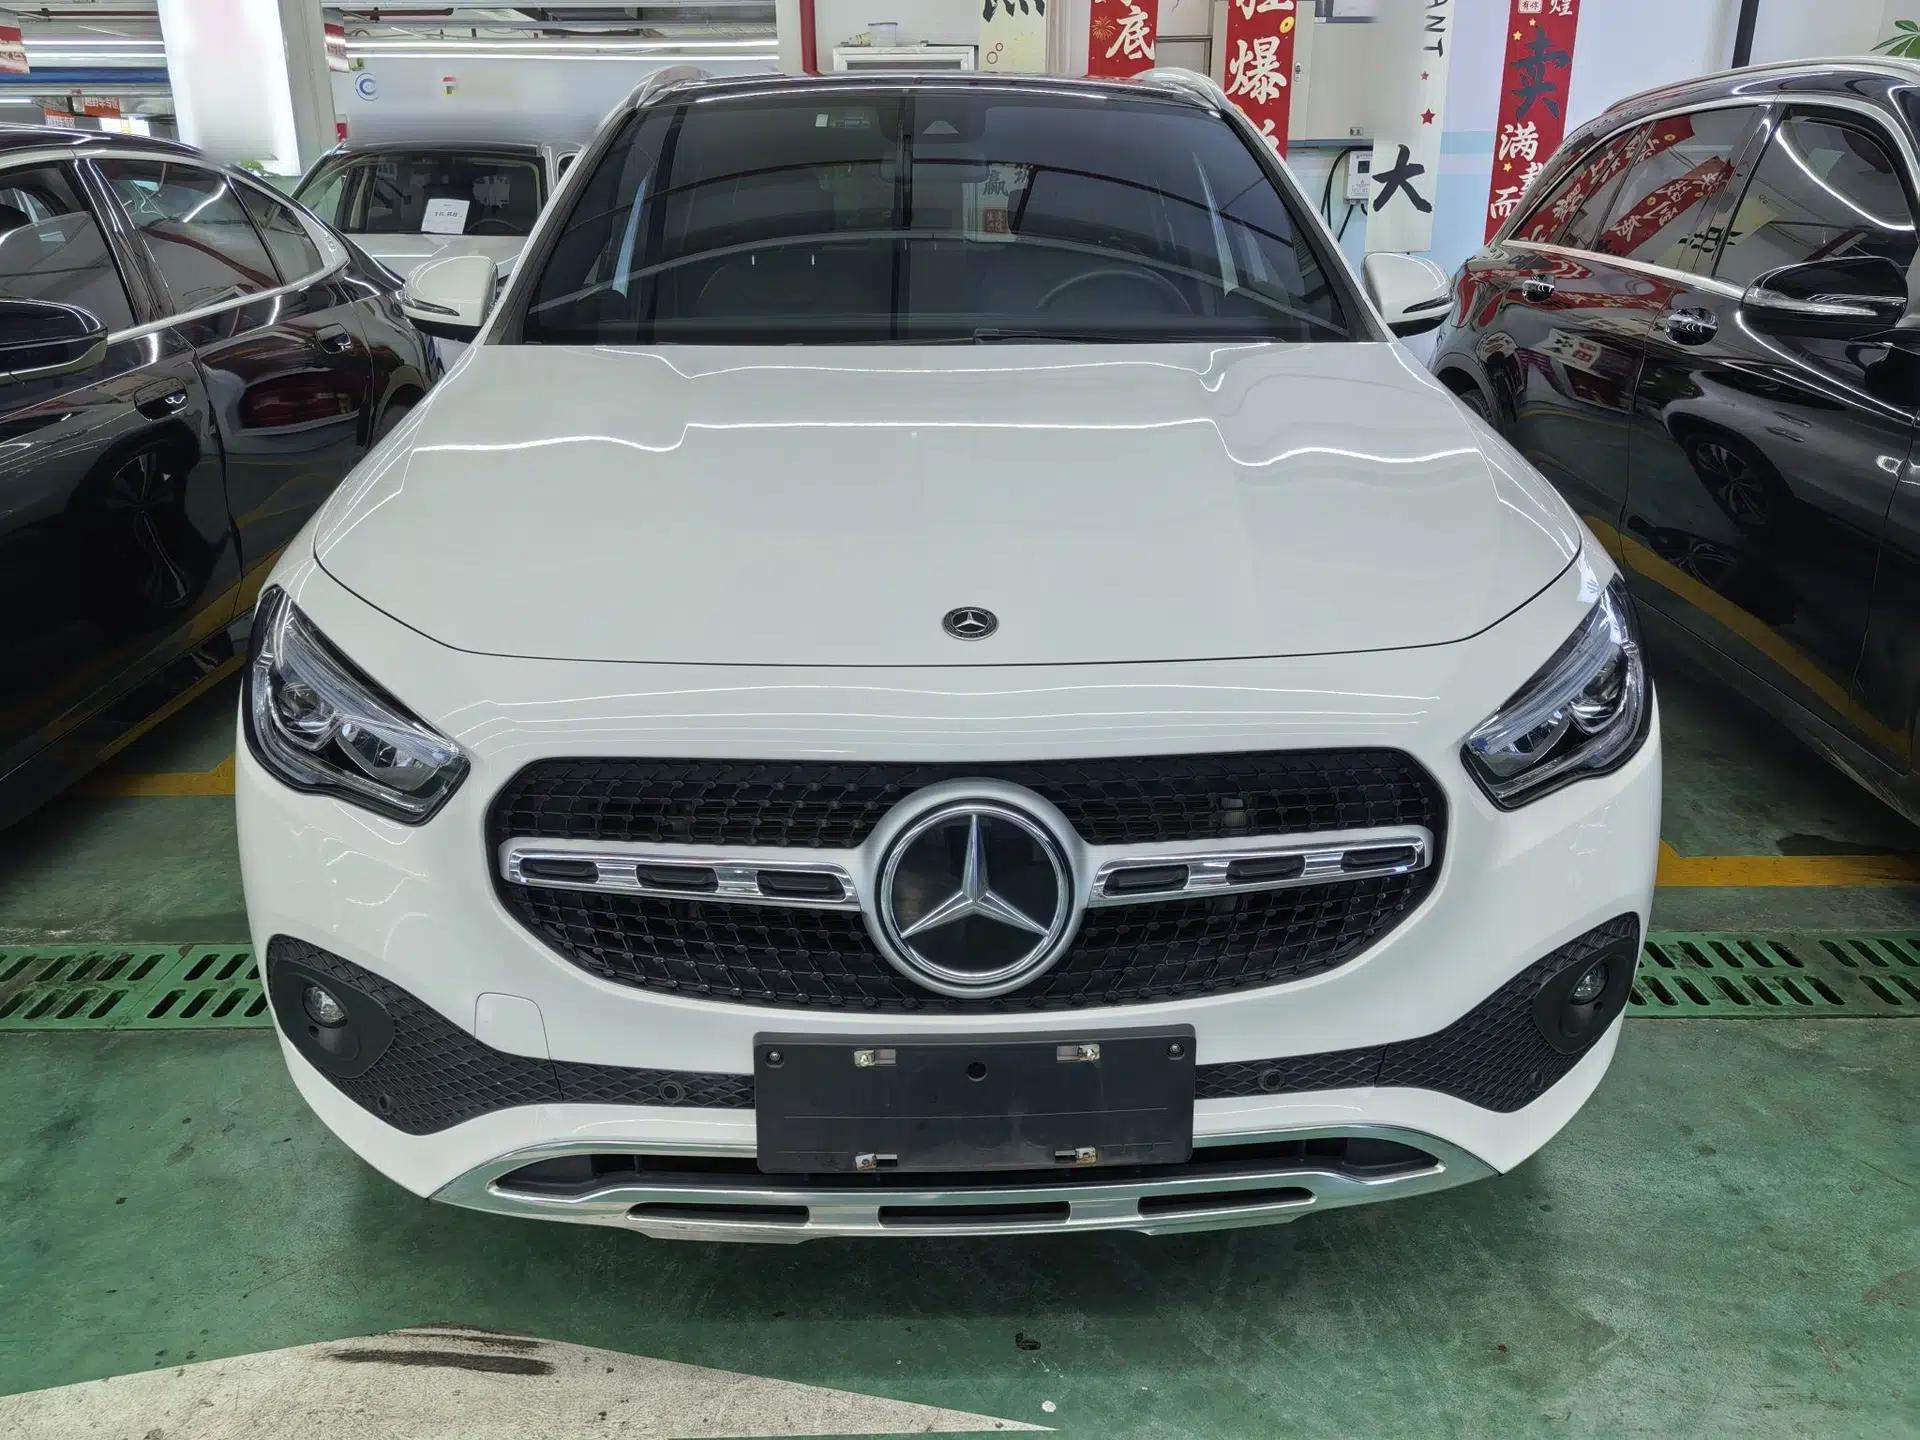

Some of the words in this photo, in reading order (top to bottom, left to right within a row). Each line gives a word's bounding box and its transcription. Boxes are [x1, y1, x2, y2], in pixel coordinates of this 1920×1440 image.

[1094, 0, 1156, 60] 底
[1510, 26, 1573, 120] 卖
[1372, 144, 1433, 213] 大
